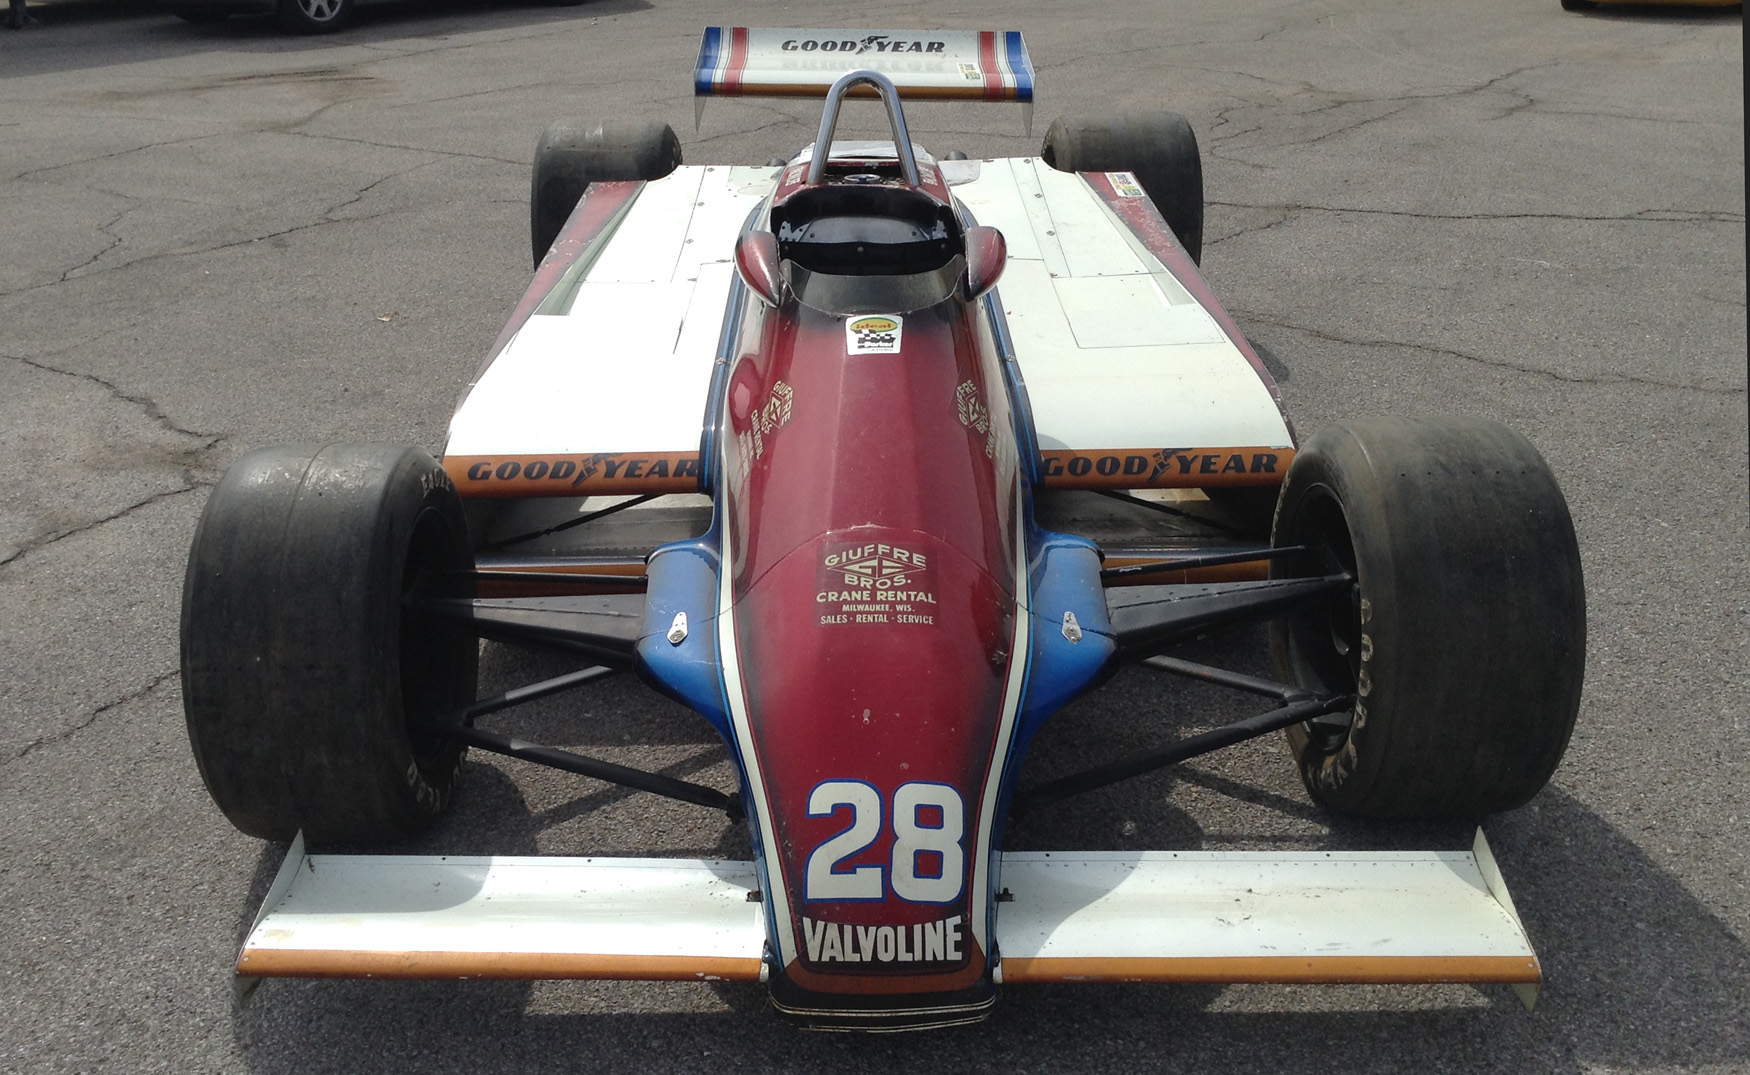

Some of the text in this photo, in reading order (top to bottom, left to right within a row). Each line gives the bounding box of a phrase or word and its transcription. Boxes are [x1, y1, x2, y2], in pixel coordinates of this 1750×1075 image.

[824, 543, 927, 567] GIUFFRE
[844, 573, 911, 589] BROS.
[816, 590, 937, 604] CRANE RENTAL
[842, 604, 915, 613] MILWAUKEE, WIS.
[820, 614, 934, 625] SALES RENTAL SERVICE
[803, 778, 966, 905] 28
[802, 915, 963, 962] VALVOLINE
